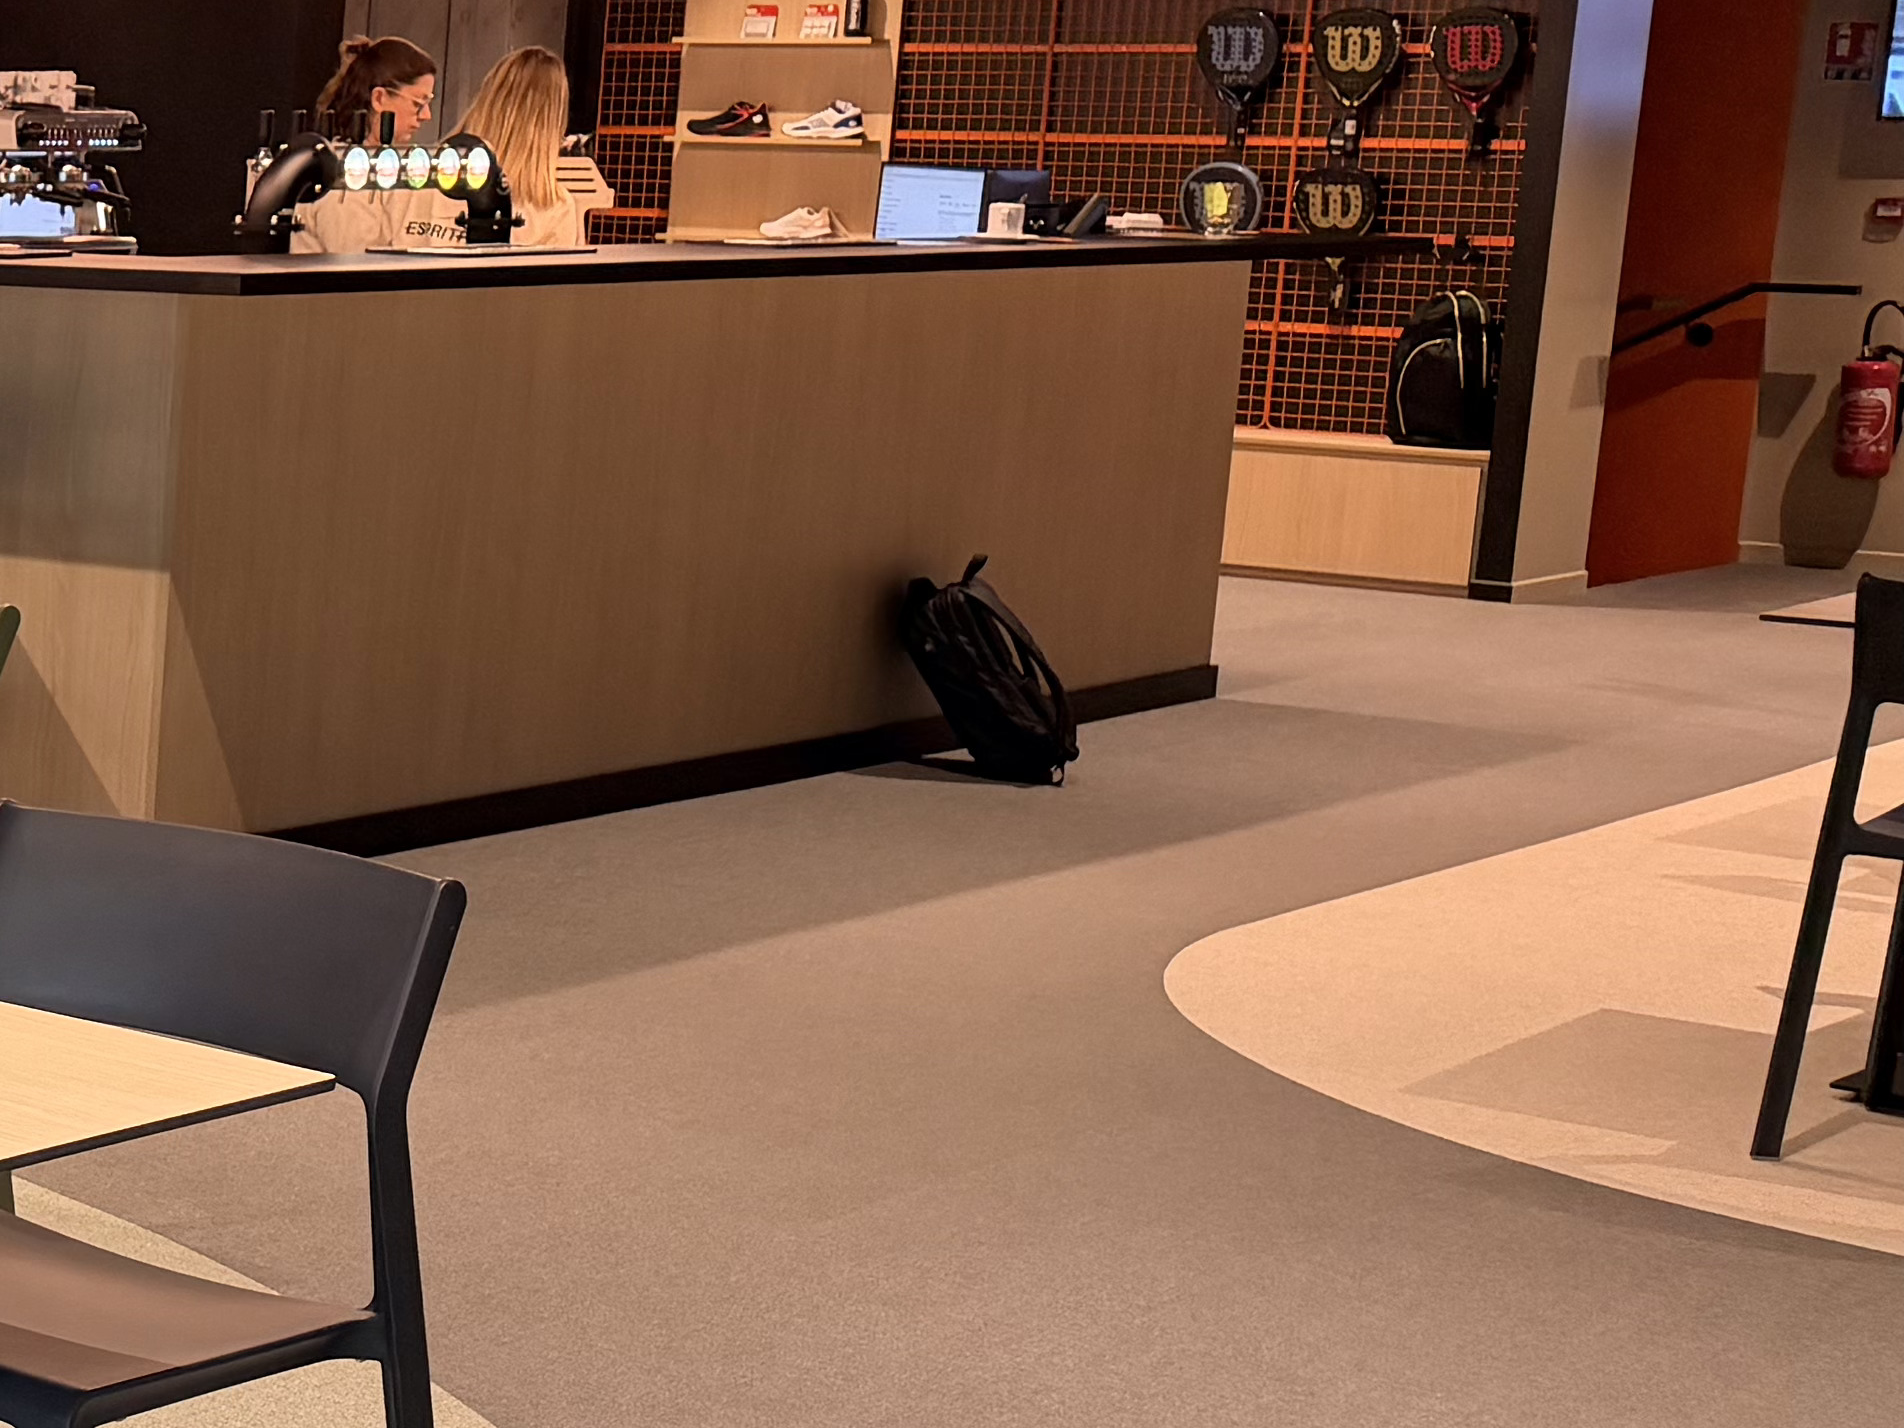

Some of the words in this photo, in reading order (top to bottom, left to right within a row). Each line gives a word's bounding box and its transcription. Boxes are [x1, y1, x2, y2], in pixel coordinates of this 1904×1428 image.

[1207, 24, 1264, 73] W
[1324, 25, 1382, 73] W
[1443, 25, 1503, 73] W
[1304, 183, 1363, 229] W
